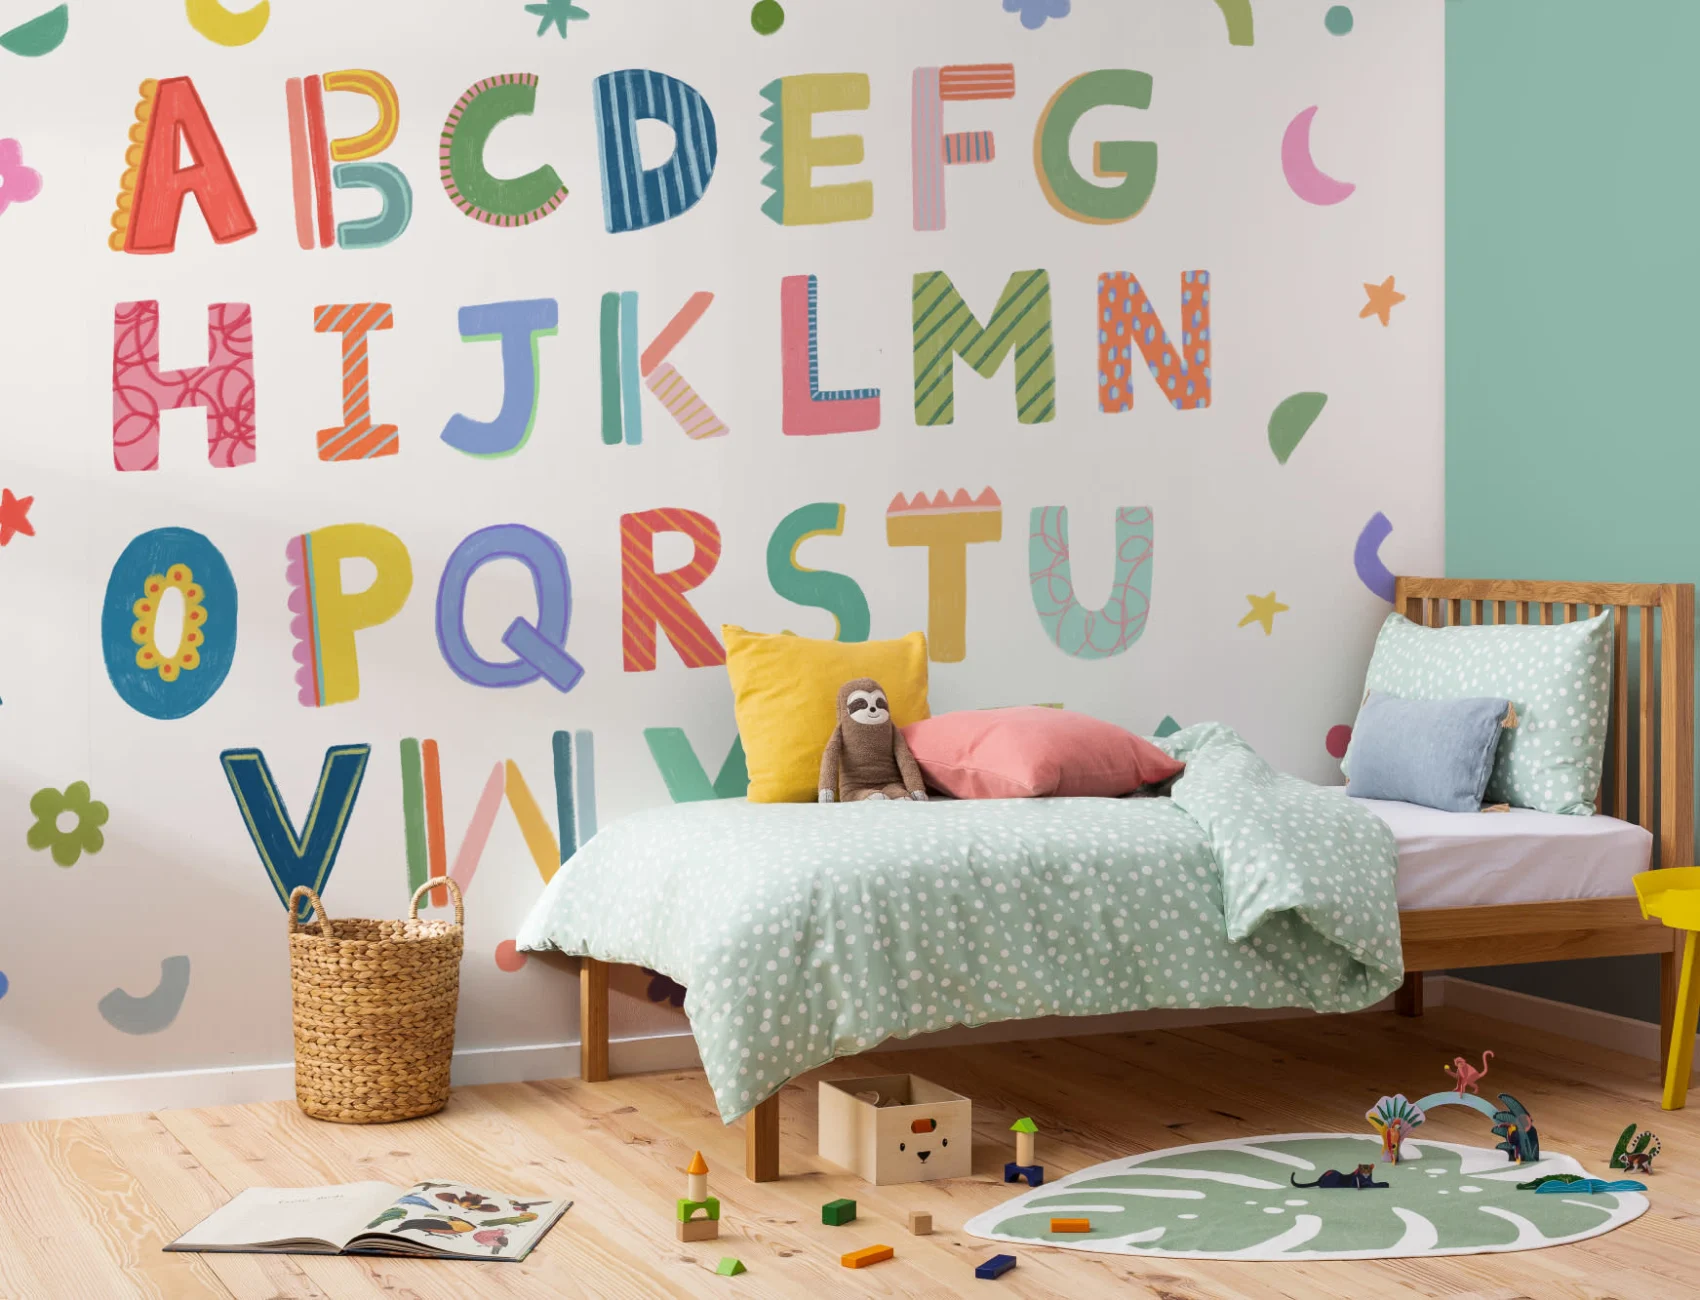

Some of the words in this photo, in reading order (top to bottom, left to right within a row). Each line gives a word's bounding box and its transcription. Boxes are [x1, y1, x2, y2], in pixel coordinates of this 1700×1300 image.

[109, 75, 257, 255] A
[286, 69, 413, 250] B
[440, 73, 569, 227] C
[592, 68, 717, 233] D
[760, 73, 874, 226] E
[911, 63, 1015, 231] F
[1033, 68, 1158, 225] G
[113, 300, 257, 471] H
[314, 302, 399, 462] I
[440, 298, 558, 460] J
[600, 291, 730, 445] K
[780, 274, 881, 436] L
[912, 268, 1056, 426] M
[1098, 270, 1212, 414] N
[101, 526, 238, 720] O
[286, 523, 413, 708] P
[436, 523, 584, 693] Q
[619, 507, 726, 672] R
[766, 502, 871, 643] S
[886, 486, 1002, 663] T
[1029, 505, 1154, 660] U
[219, 743, 371, 922] V
[400, 729, 597, 908] W
